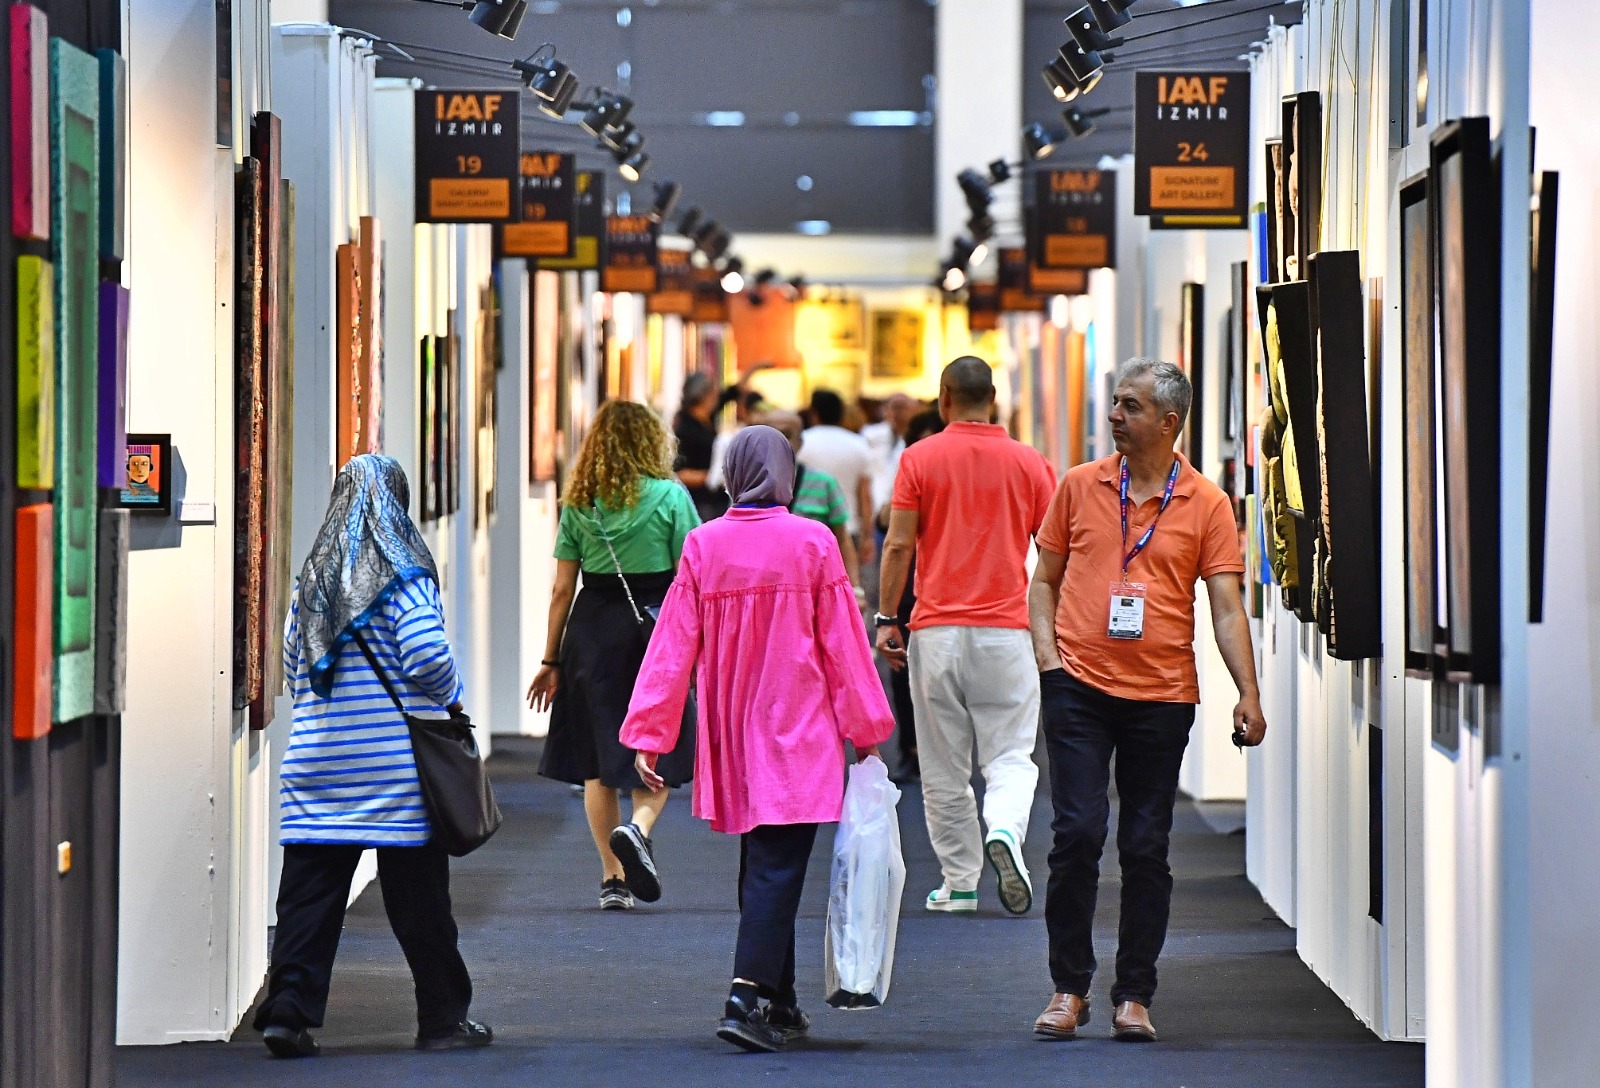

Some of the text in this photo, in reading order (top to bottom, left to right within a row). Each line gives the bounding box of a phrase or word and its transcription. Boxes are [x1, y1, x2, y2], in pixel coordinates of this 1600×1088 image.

[1157, 76, 1228, 105] IAAF
[436, 94, 502, 121] IAAF
[1177, 142, 1209, 162] 24
[456, 155, 483, 175] 19
[1160, 190, 1179, 199] ART
[1180, 190, 1224, 200] GALLERY
